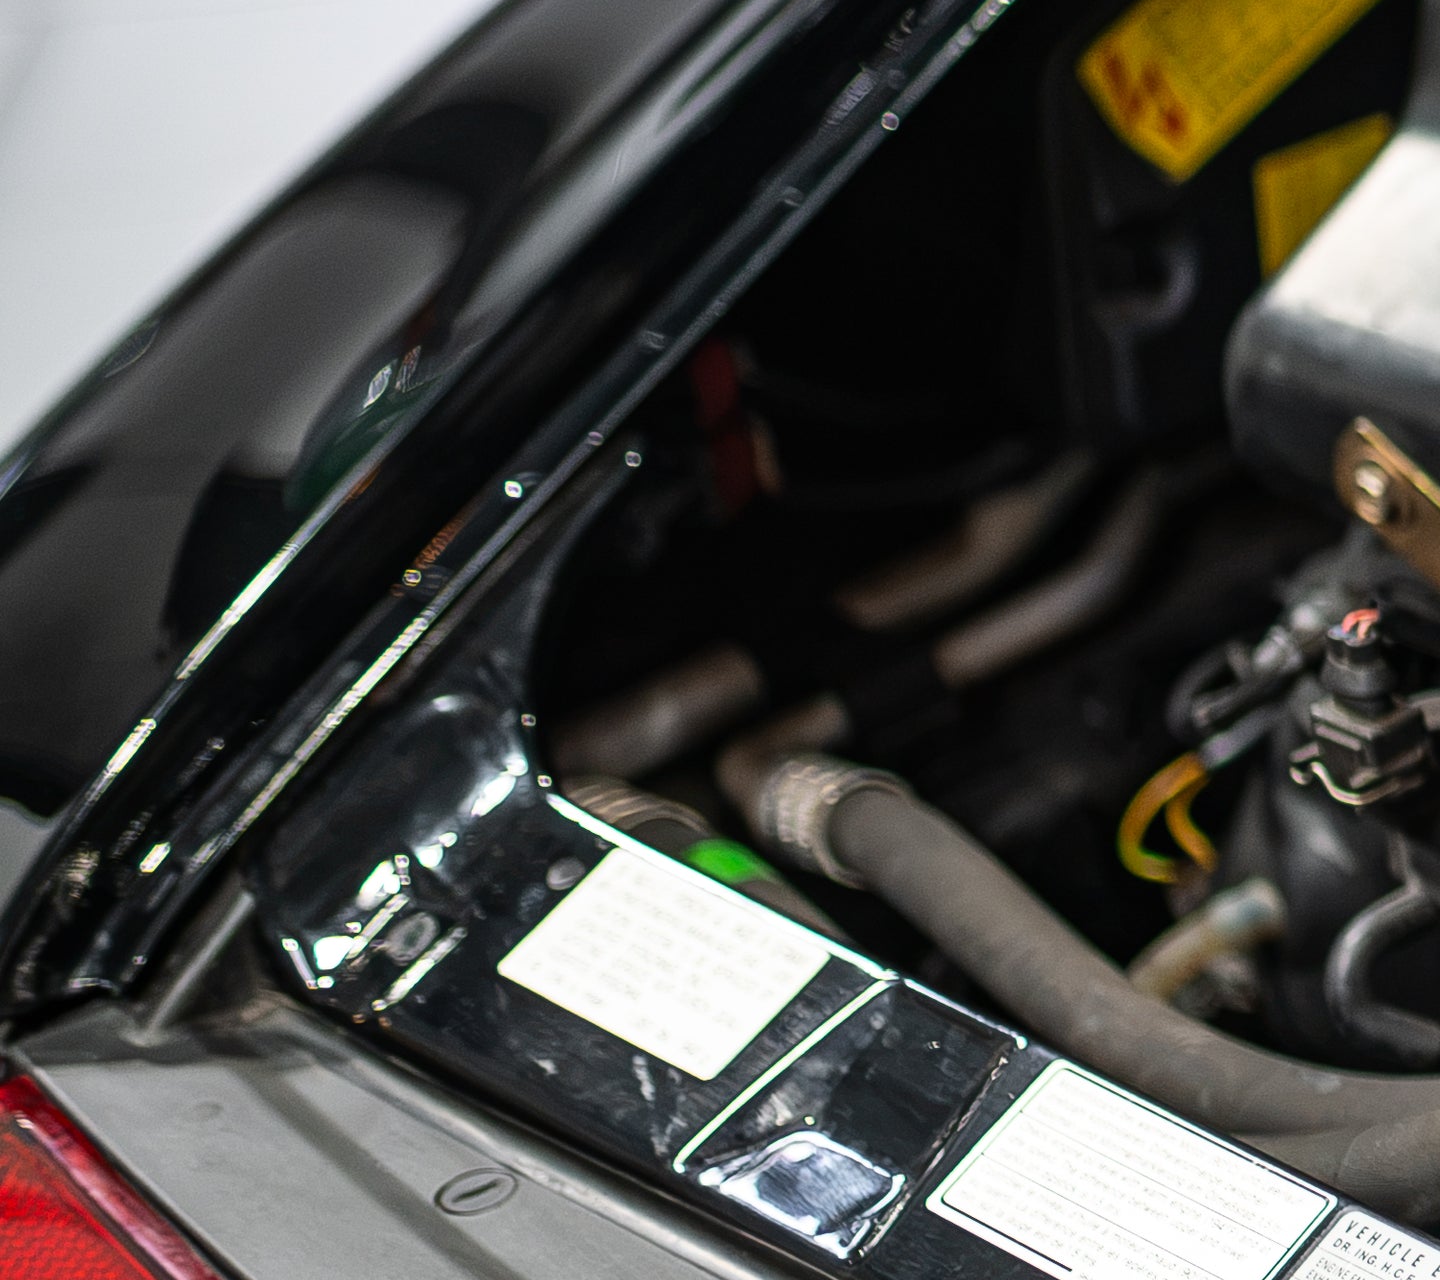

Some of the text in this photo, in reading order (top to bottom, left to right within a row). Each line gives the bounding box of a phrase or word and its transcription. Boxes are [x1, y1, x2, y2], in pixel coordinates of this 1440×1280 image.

[1330, 1237, 1355, 1254] DR.
[1351, 1247, 1382, 1268] ING.
[1341, 1219, 1427, 1269] VEHICLE
[1313, 1256, 1351, 1280] ENGINE
